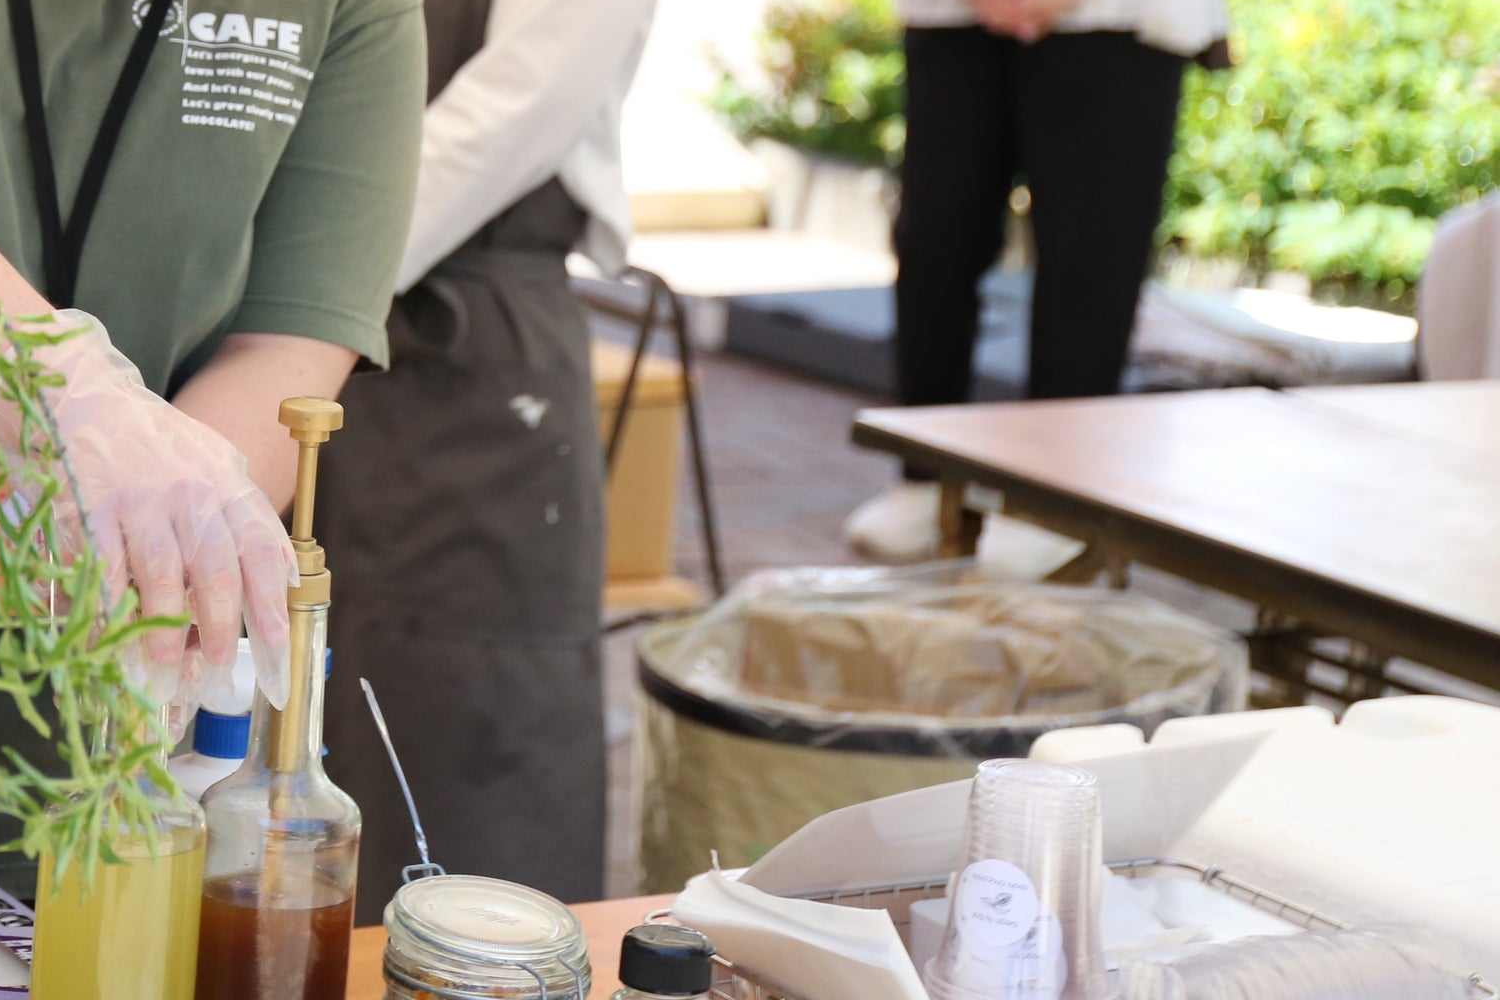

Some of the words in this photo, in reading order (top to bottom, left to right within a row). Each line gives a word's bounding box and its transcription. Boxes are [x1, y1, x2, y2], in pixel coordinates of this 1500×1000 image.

[189, 12, 303, 54] CAFE
[187, 47, 213, 61] Let's
[215, 67, 245, 78] with
[182, 81, 210, 93] And
[182, 98, 211, 110] Let's
